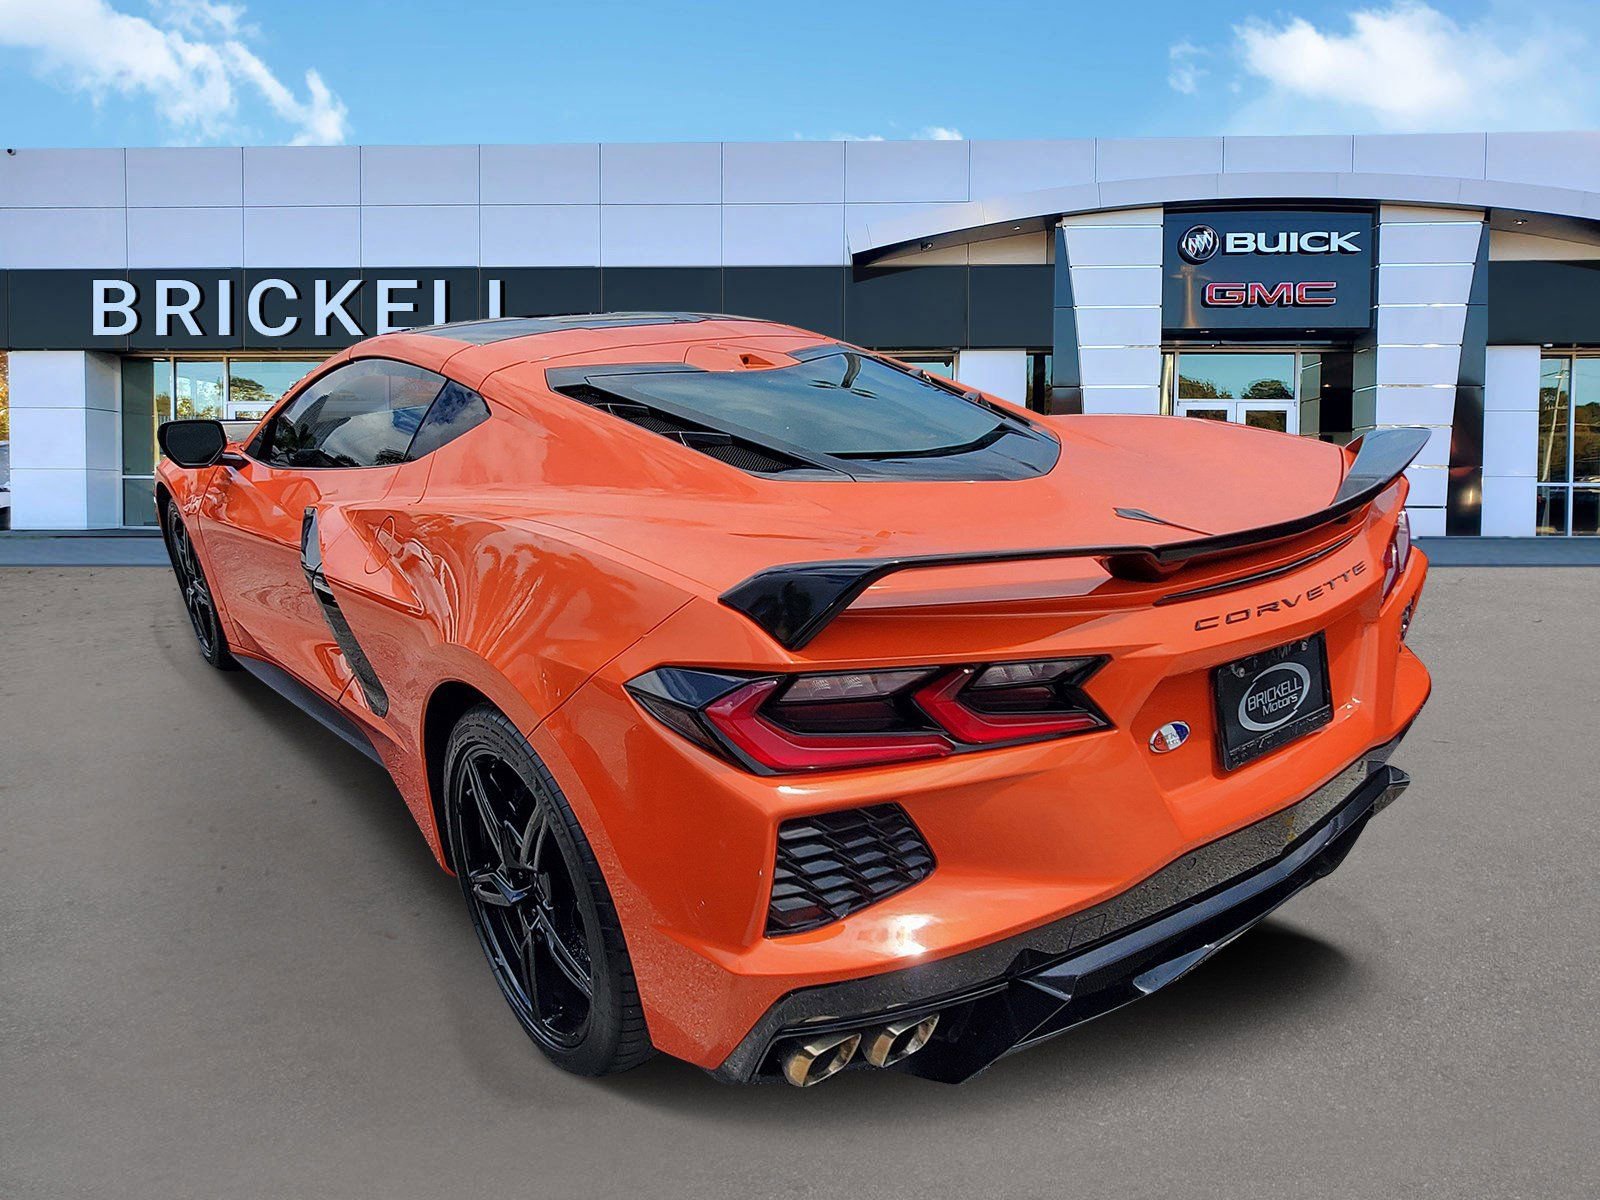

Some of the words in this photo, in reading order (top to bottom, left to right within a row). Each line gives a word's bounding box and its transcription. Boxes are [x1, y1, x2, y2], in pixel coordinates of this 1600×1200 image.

[1226, 231, 1362, 252] BUICK
[1205, 282, 1337, 305] GMC
[1194, 560, 1367, 632] CORVETTE
[1247, 677, 1303, 712] BRICKELL
[1262, 693, 1299, 716] Motors
